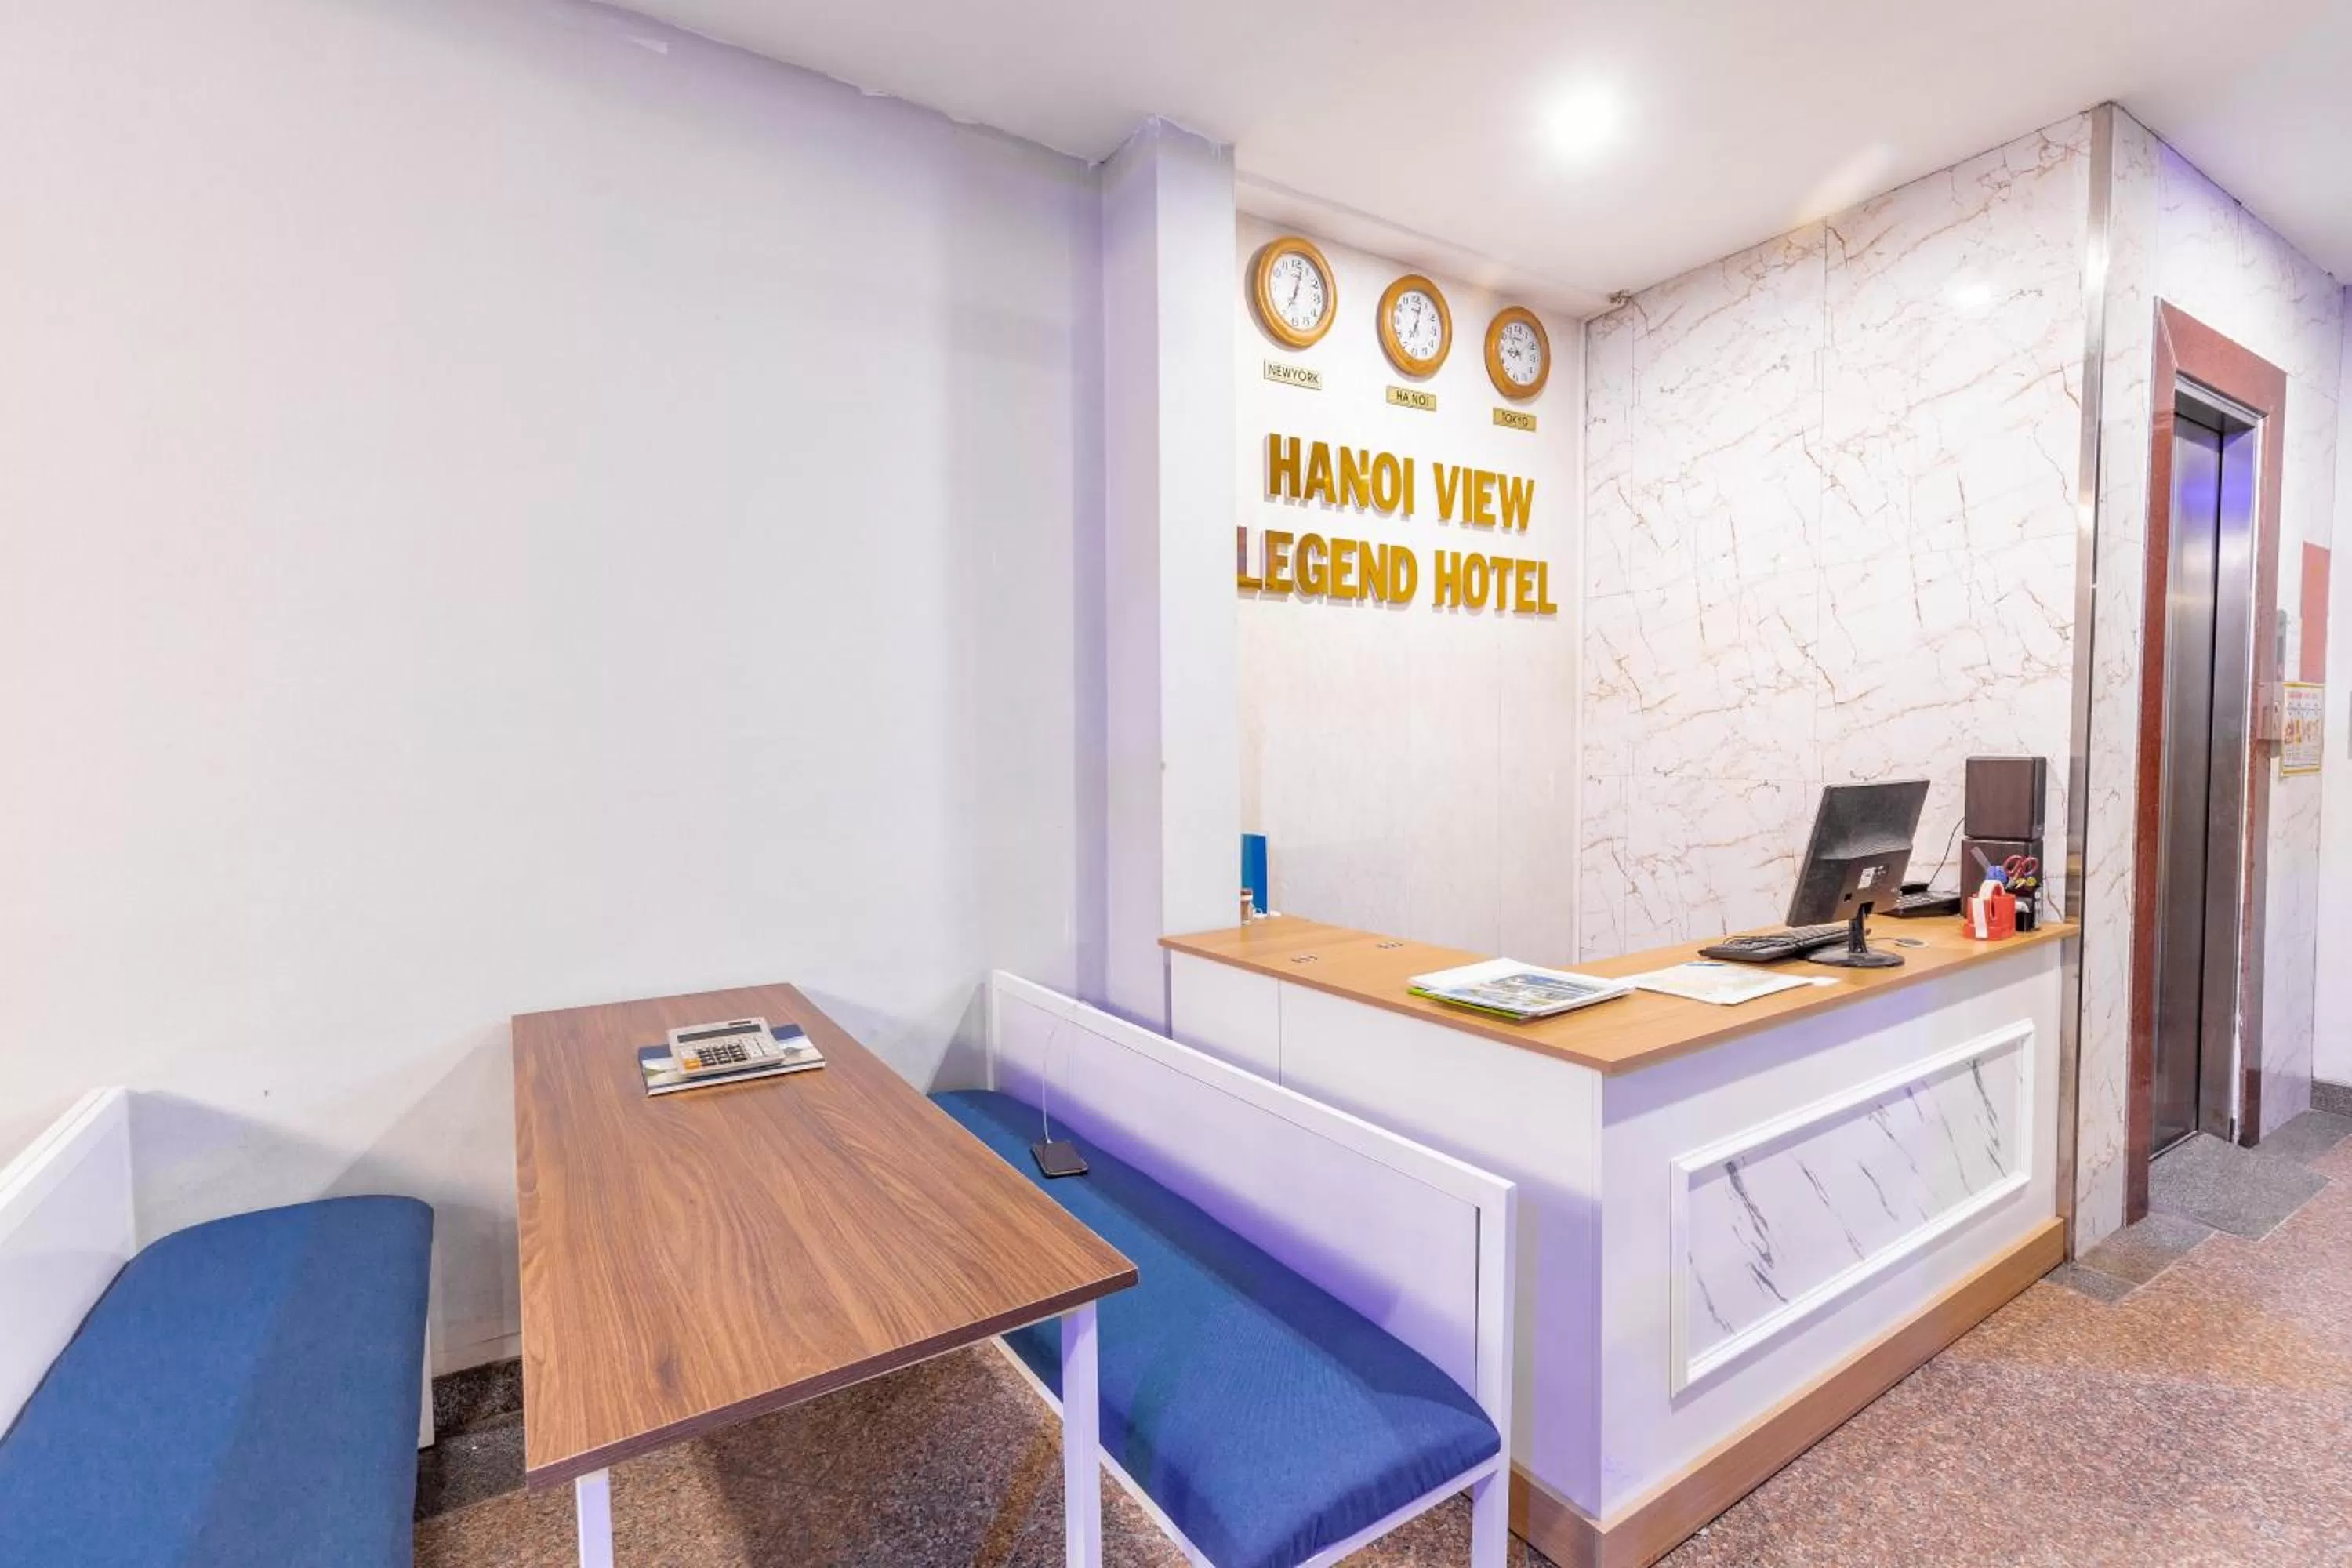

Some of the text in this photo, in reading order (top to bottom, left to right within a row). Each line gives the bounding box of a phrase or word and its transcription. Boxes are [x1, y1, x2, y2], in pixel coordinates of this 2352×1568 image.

[1268, 364, 1319, 383] NEWYORK
[1266, 433, 1534, 531] HANOI VIEW
[1236, 526, 1558, 615] LEGEND HOTEL
